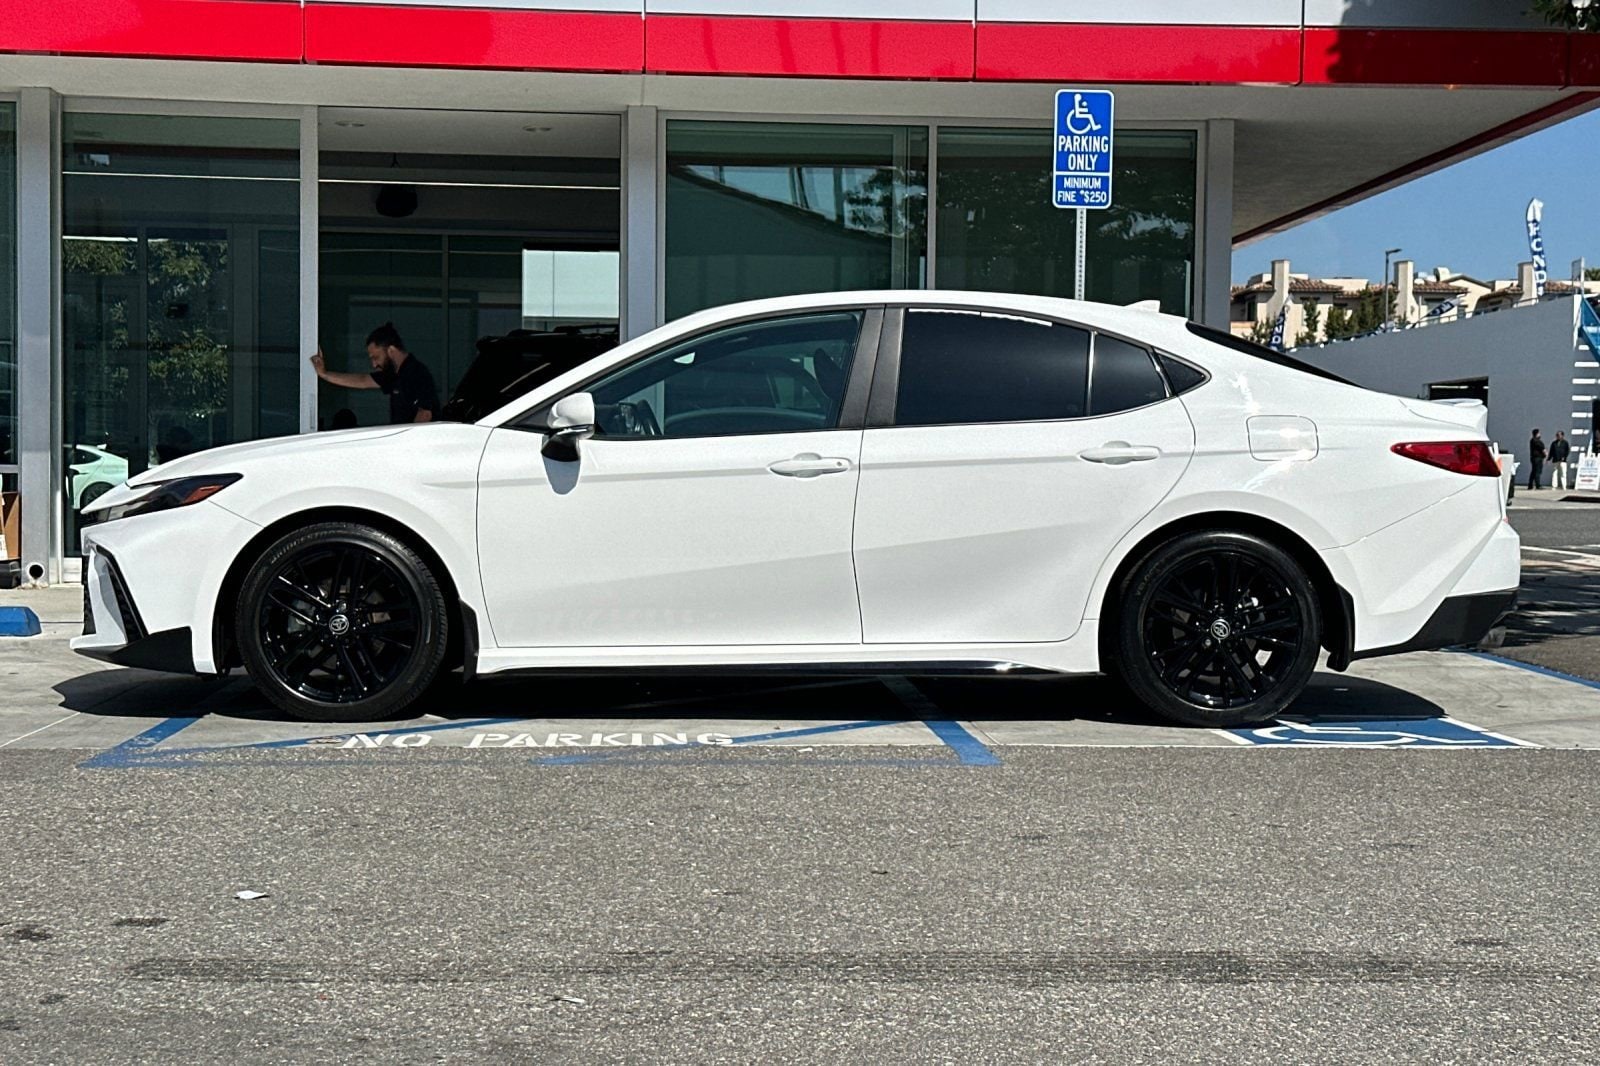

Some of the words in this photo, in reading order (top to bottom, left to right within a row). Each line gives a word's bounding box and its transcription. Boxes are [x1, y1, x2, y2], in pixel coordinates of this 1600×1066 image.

[1058, 135, 1109, 153] PARKING
[1068, 153, 1098, 171] ONLY
[1063, 177, 1102, 189] MINIMUM
[1057, 190, 1077, 202] FINE
[341, 733, 433, 748] NO
[465, 732, 734, 748] PARKING
